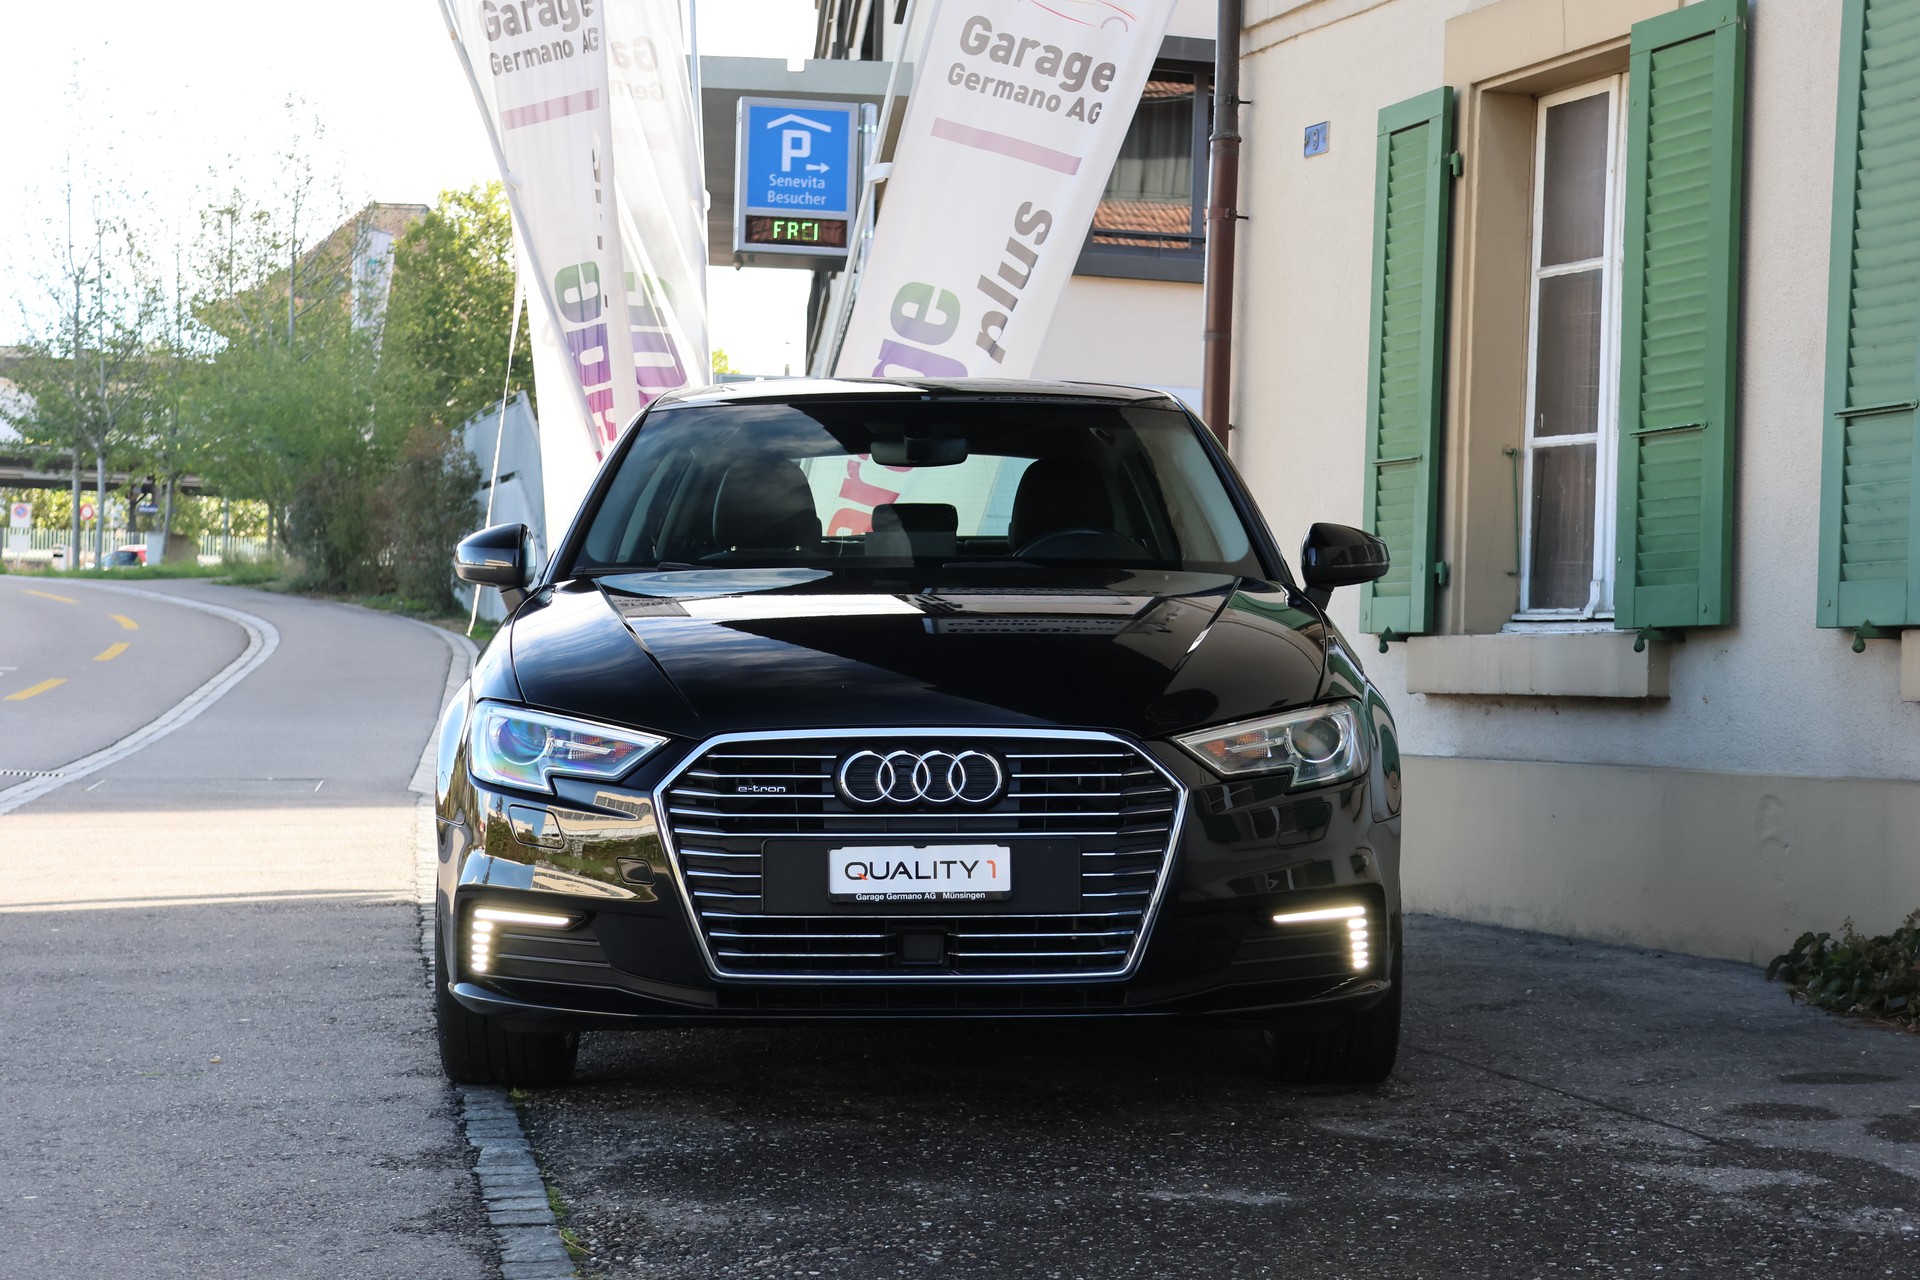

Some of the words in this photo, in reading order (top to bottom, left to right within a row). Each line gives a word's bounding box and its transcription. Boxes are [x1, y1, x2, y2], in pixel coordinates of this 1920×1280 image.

[490, 39, 574, 76] Germano
[582, 27, 599, 54] AG
[960, 15, 1116, 93] Garage
[947, 62, 1061, 113] Germano
[1065, 96, 1103, 125] AG
[781, 129, 811, 172] P
[767, 190, 827, 205] Besucher
[769, 174, 826, 189] Senevita
[975, 201, 1053, 364] plus
[738, 785, 786, 793] e-tron
[844, 860, 980, 881] QUALITY
[986, 860, 997, 879] 1
[855, 893, 884, 902] Garage
[886, 892, 922, 901] Germano
[924, 892, 936, 900] AG
[942, 891, 986, 902] Münsingen
